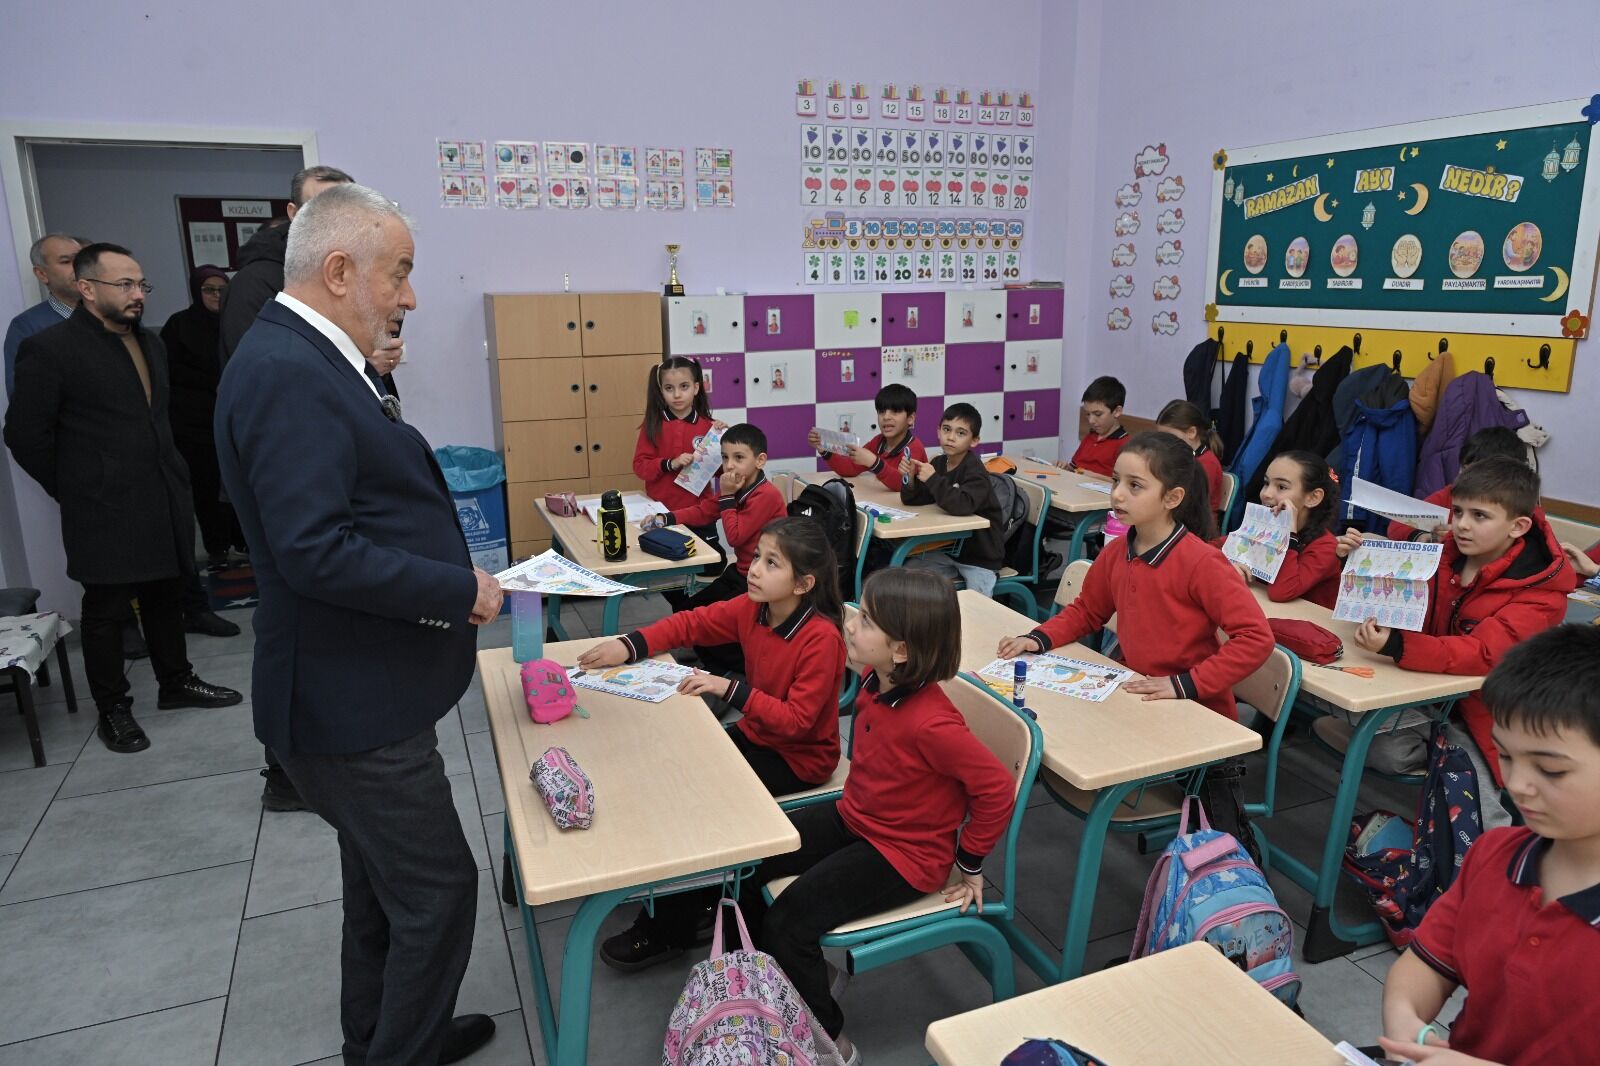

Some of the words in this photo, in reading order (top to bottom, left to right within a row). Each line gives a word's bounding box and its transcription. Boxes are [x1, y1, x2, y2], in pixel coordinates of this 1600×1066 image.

[803, 100, 811, 110] 3
[833, 104, 840, 113] 6
[856, 104, 863, 113] 9
[886, 104, 896, 114] 12
[910, 106, 921, 116] 15
[938, 109, 948, 118] 18
[958, 109, 969, 119] 21
[981, 111, 992, 120] 24
[999, 111, 1010, 121] 27
[1020, 112, 1031, 122] 30
[803, 145, 821, 159] 10
[827, 147, 847, 161] 20
[851, 147, 872, 161] 30
[876, 149, 896, 162] 40
[901, 150, 921, 163] 50
[924, 150, 943, 164] 60
[948, 152, 965, 164] 70
[970, 152, 988, 164] 80
[992, 154, 1010, 166] 90
[1013, 156, 1033, 166] 100
[810, 191, 818, 204] 2
[834, 191, 843, 204] 4
[859, 192, 867, 204] 6
[883, 193, 891, 205] 8
[905, 193, 917, 205] 10
[928, 193, 939, 206] 12
[949, 192, 961, 205] 14
[973, 193, 984, 206] 16
[994, 196, 1005, 208] 18
[1014, 197, 1027, 209] 20
[1246, 174, 1318, 219] RAMAZAN
[1357, 168, 1392, 193] AYI
[228, 206, 264, 215] KIZILAY
[848, 222, 858, 235] 5
[865, 222, 880, 234] 10
[883, 221, 898, 234] 15
[921, 222, 935, 234] 25
[939, 222, 954, 234] 30
[958, 222, 971, 234] 35
[1009, 223, 1022, 235] 50
[810, 269, 819, 281] 4
[833, 270, 840, 280] 8
[853, 269, 865, 280] 12
[875, 269, 887, 281] 16
[895, 269, 912, 280] 20
[918, 268, 932, 279] 24
[941, 268, 953, 279] 28
[963, 269, 975, 279] 32
[984, 269, 998, 279] 36
[1003, 267, 1019, 278] 40
[1360, 540, 1392, 549] RAMAZA
